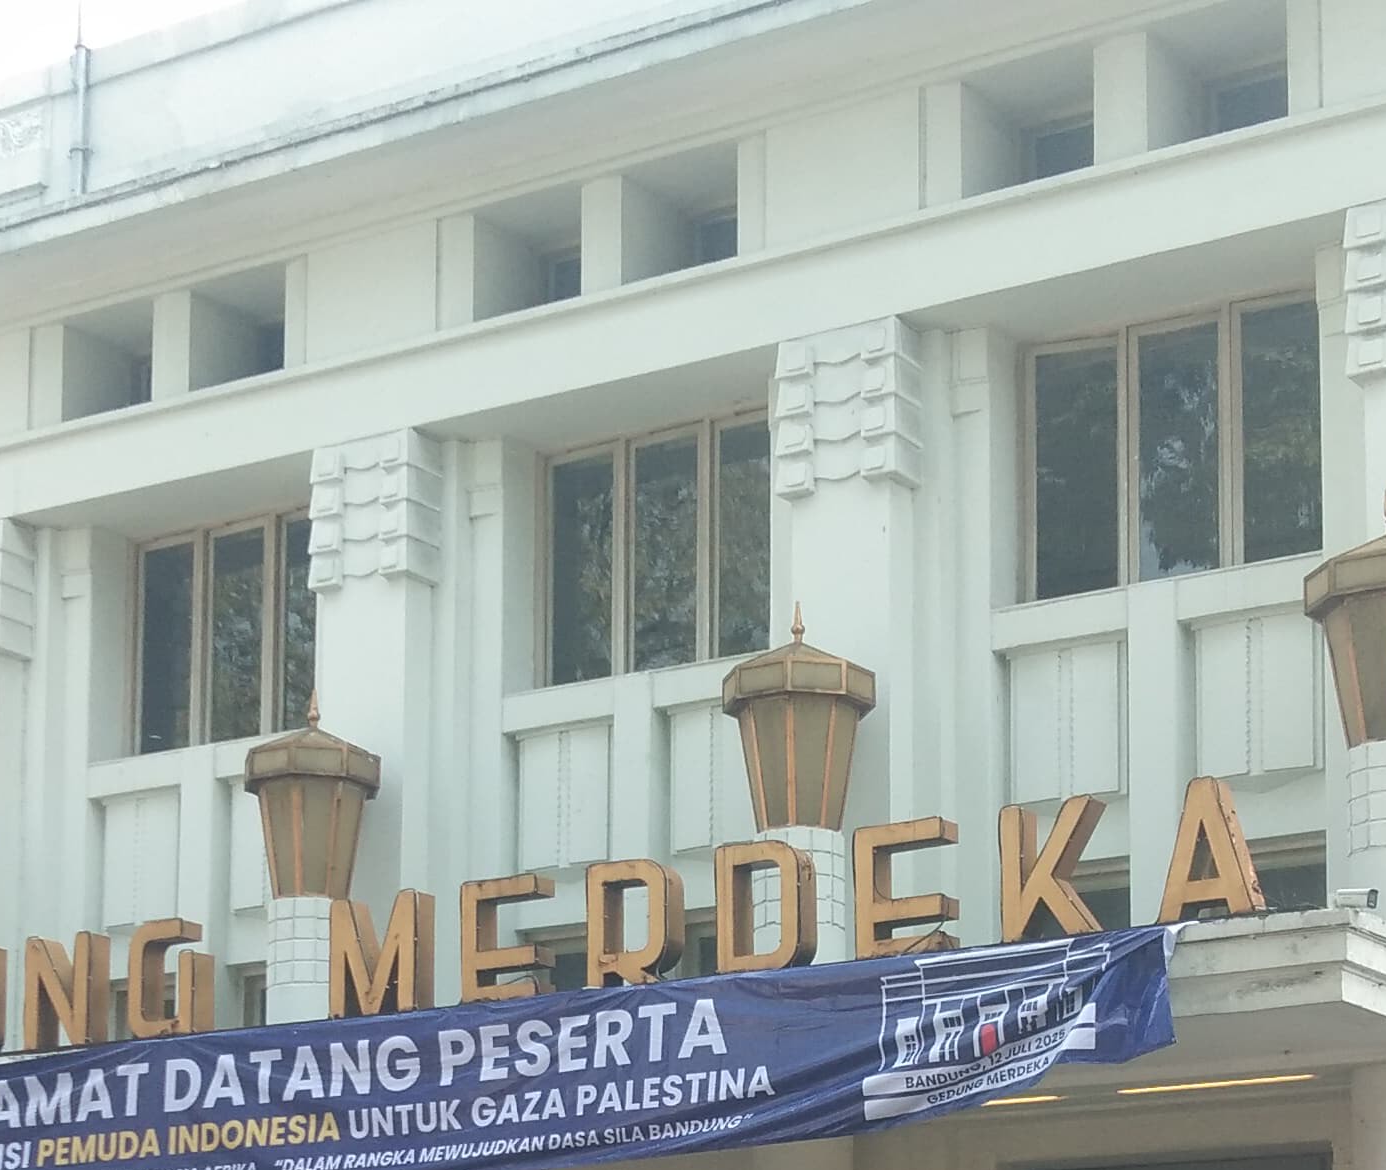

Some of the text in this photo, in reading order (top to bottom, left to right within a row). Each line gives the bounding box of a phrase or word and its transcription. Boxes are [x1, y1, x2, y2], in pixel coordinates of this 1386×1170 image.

[328, 776, 1266, 1020] MERDEKA
[164, 1036, 421, 1113] DATANG
[438, 998, 727, 1087] PESERTA
[905, 1029, 1066, 1089] BANDUNG, 12 JULI 2025
[927, 1056, 1050, 1105] GEDUNG MERDEKA
[36, 1128, 161, 1167] PEMUDA
[168, 1111, 341, 1156] INDONESIA
[348, 1099, 463, 1139] UNTUK
[471, 1088, 566, 1127] GAZA
[576, 1066, 775, 1116] PALESTINA
[344, 1148, 415, 1170] RANGKA
[419, 1135, 545, 1165] MEWUJUDKAN
[548, 1129, 600, 1150] DASA
[603, 1126, 645, 1145] SILA
